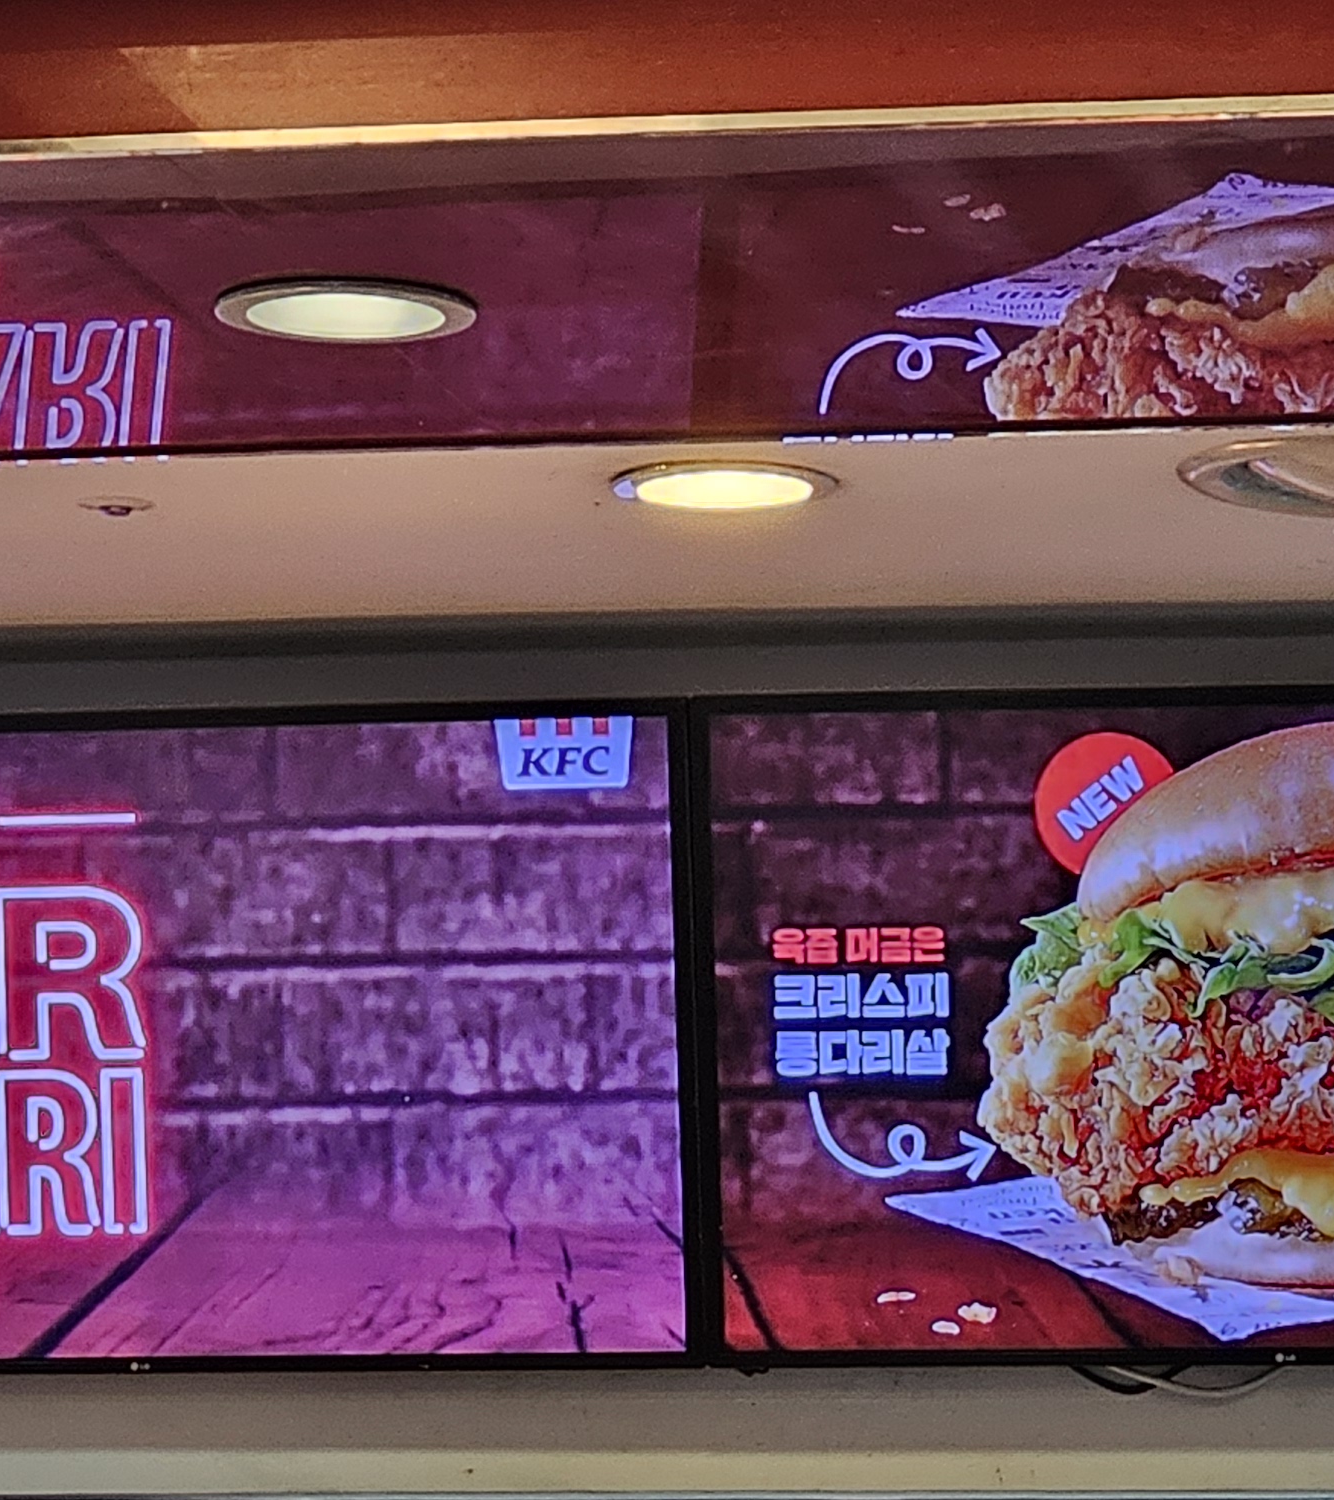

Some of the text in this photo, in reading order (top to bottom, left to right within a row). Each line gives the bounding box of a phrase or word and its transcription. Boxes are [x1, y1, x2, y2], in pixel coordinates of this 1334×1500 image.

[517, 744, 611, 778] KFC
[1055, 754, 1146, 842] NEW
[773, 926, 945, 964] 육즙 머금은
[774, 972, 950, 1019] 크리스피
[775, 1028, 951, 1077] 통다리살
